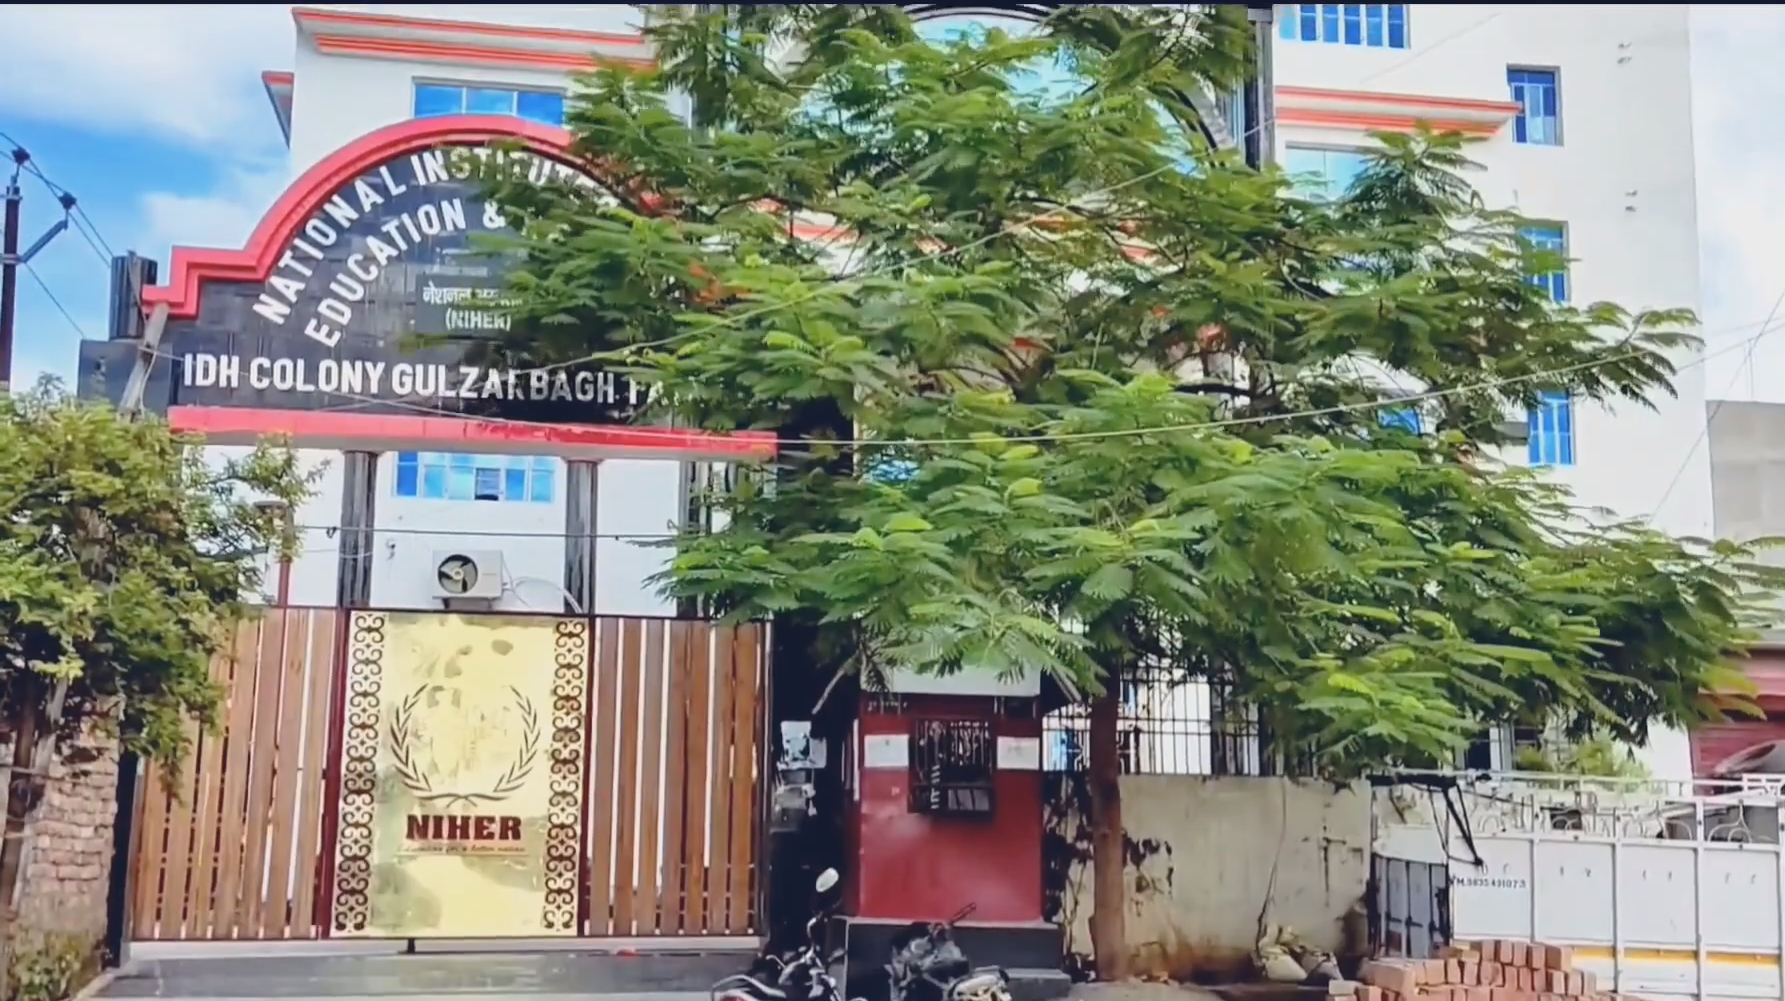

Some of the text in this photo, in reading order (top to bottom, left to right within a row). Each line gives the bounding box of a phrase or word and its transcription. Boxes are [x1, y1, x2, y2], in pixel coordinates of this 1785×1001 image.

[253, 166, 407, 325] NATIONAL
[304, 198, 506, 348] EDUCATION &
[184, 353, 239, 388] IDH
[250, 357, 386, 394] COLONY
[405, 814, 522, 840] NIHER
